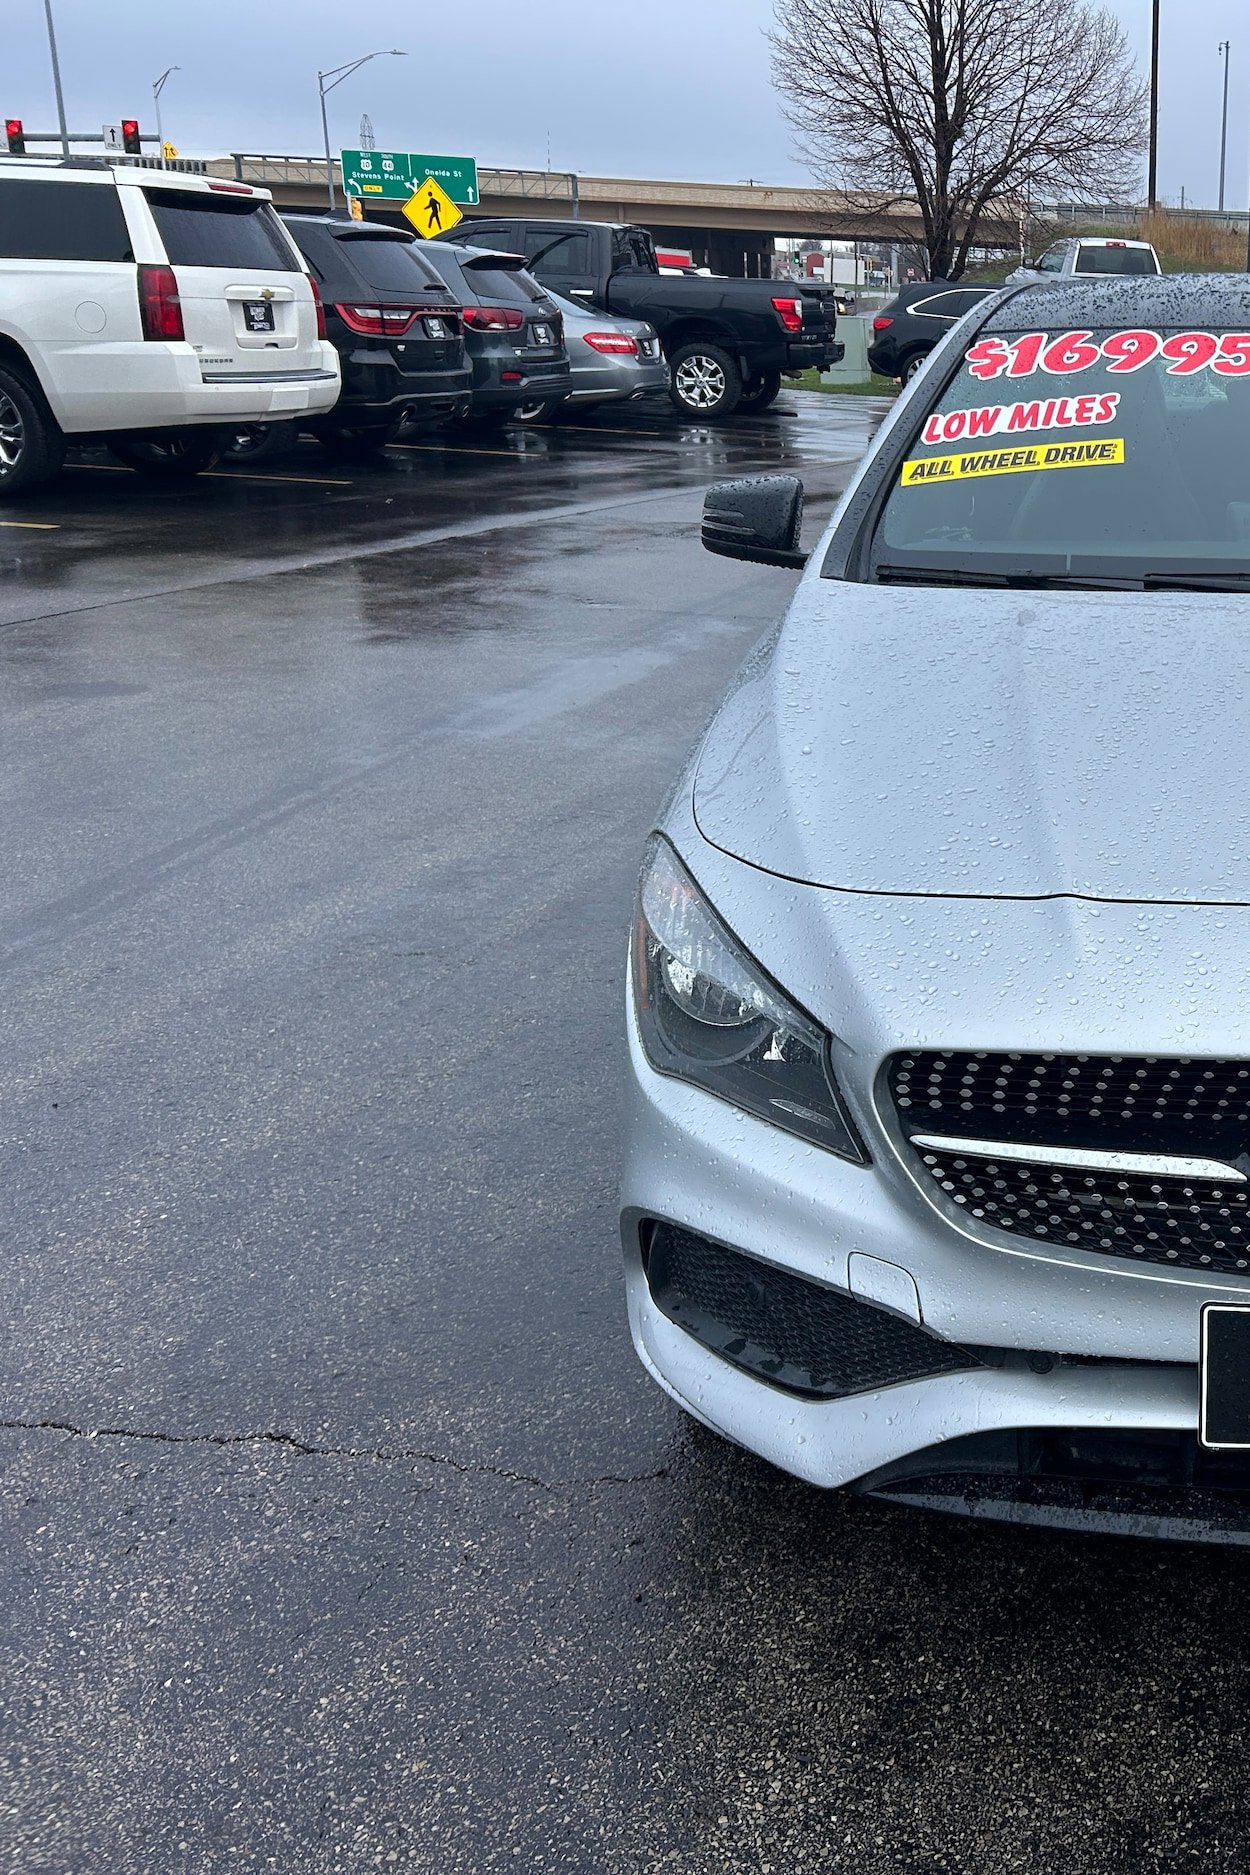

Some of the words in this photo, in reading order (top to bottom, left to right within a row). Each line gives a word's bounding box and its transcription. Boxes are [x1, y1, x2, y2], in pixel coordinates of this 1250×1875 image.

[352, 171, 381, 180] Stevens
[384, 173, 405, 181] Point
[425, 168, 450, 177] Oneida
[453, 170, 462, 178] St
[922, 406, 1001, 445] LOW
[1007, 393, 1121, 433] MILES
[908, 461, 953, 482] ALL
[960, 450, 1040, 474] WHEEL
[1048, 442, 1117, 464] DRIVE
